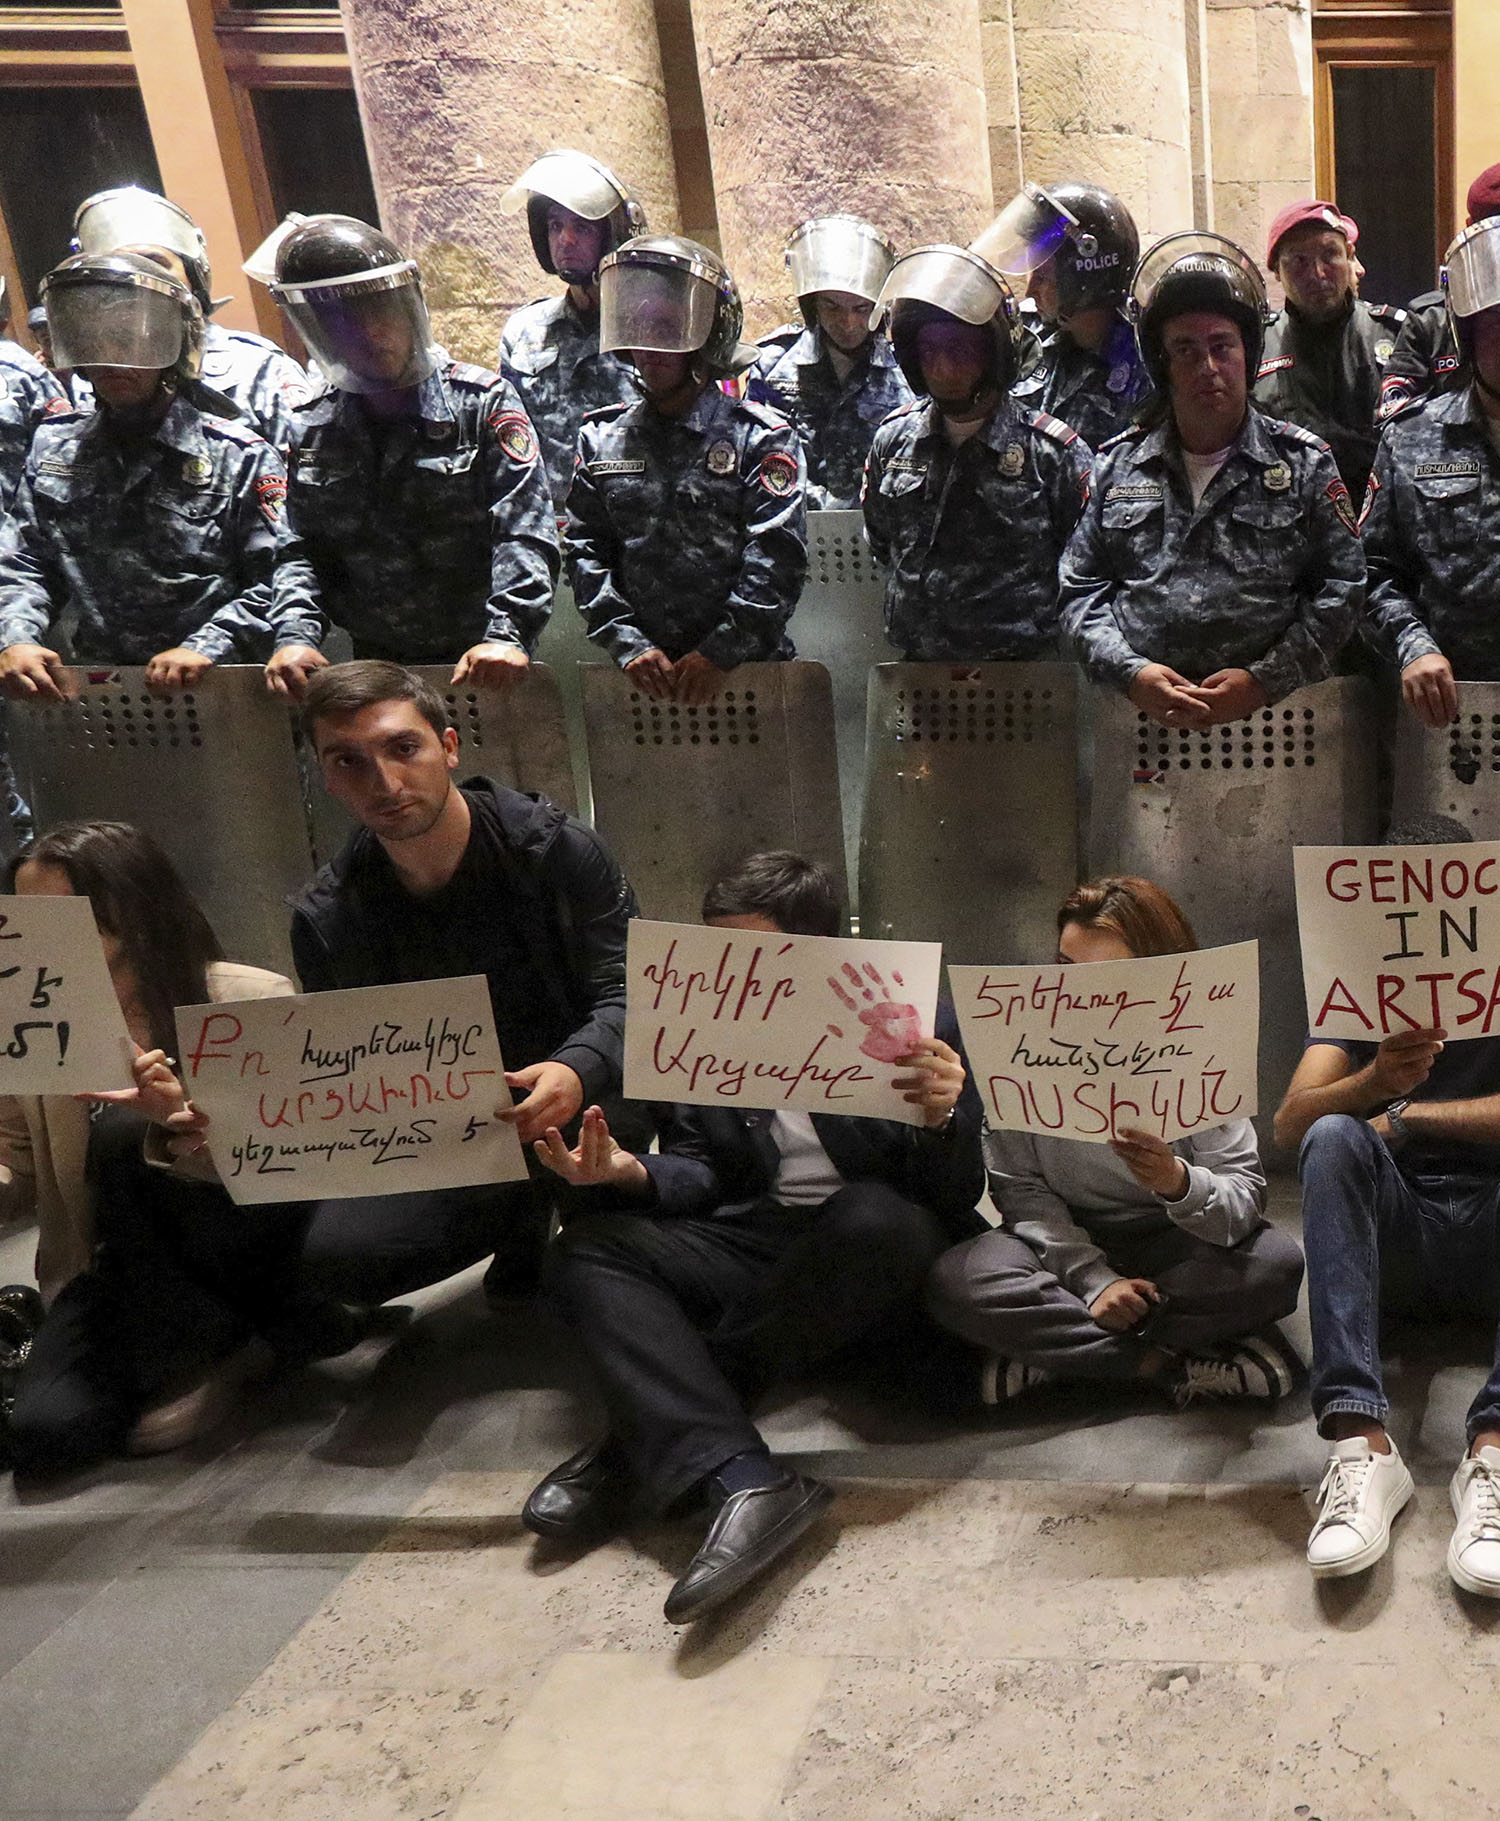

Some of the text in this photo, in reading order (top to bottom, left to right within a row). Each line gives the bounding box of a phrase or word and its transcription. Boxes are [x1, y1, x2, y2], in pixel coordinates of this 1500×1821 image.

[1075, 252, 1119, 271] POLICE
[1437, 358, 1456, 371] PO
[1383, 906, 1478, 961] IN
[461, 1116, 489, 1142] է
